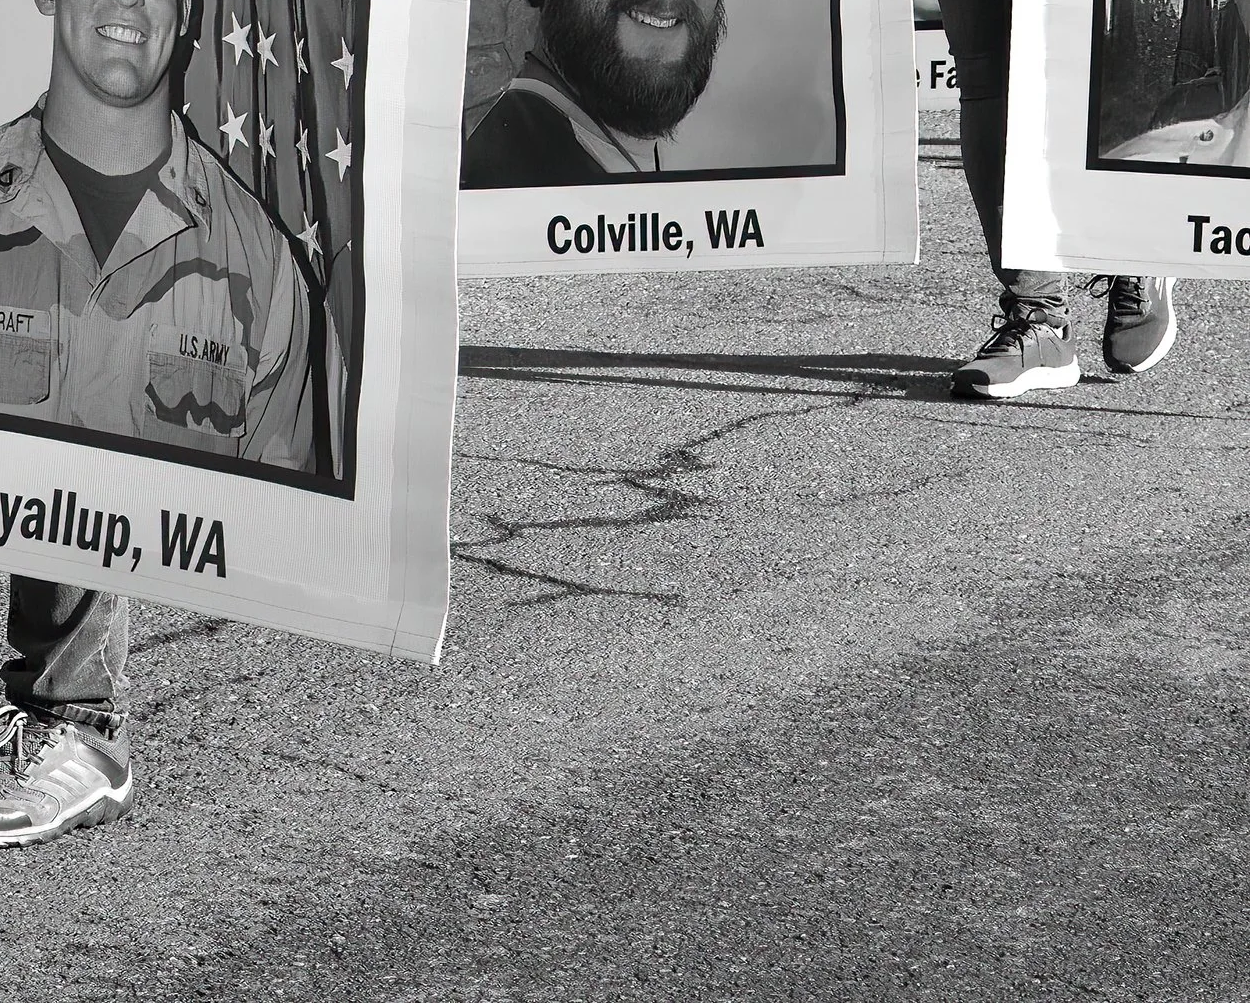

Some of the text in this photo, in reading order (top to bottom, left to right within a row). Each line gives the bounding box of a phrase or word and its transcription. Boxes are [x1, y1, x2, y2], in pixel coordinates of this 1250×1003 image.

[548, 209, 764, 258] Colville, WA
[161, 510, 226, 578] WA
